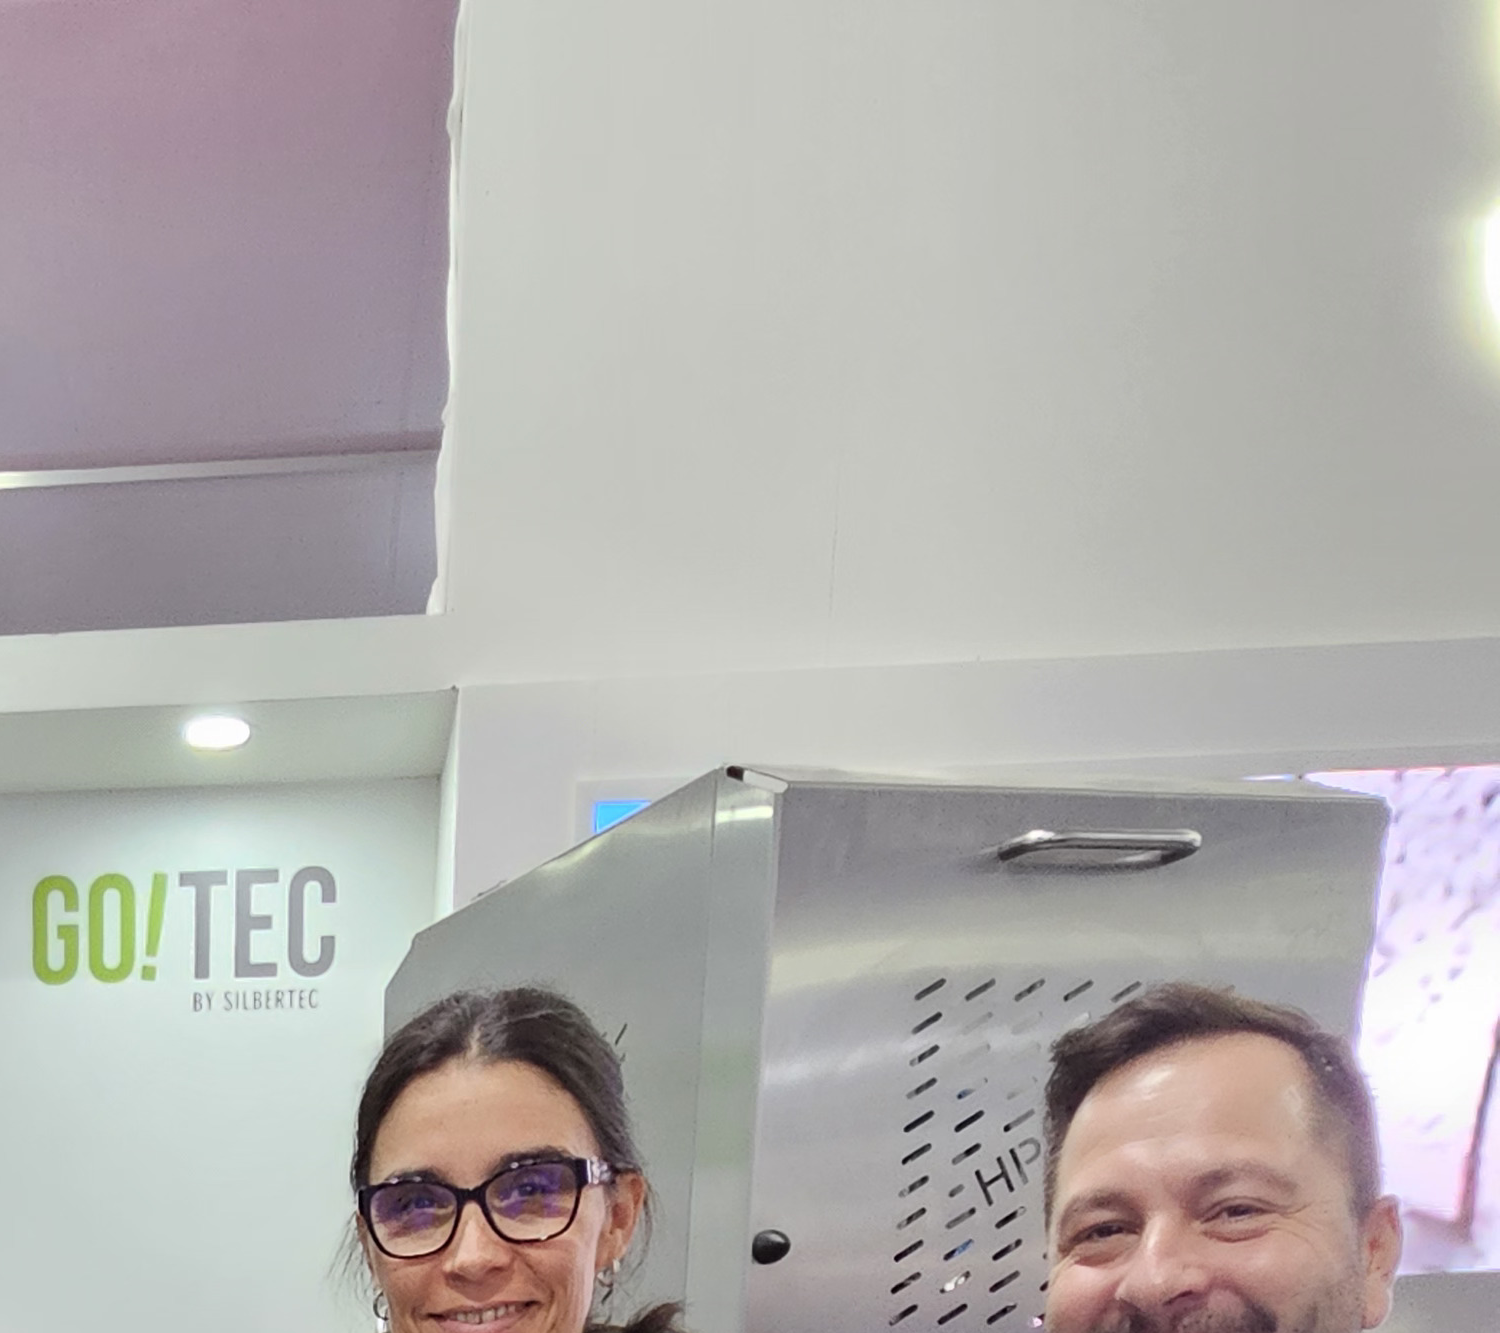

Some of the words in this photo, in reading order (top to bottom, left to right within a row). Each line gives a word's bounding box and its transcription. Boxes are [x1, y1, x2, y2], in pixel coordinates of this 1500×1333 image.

[32, 866, 337, 985] GO!TEC
[192, 991, 214, 1012] BY
[223, 988, 319, 1011] SILBERTEC
